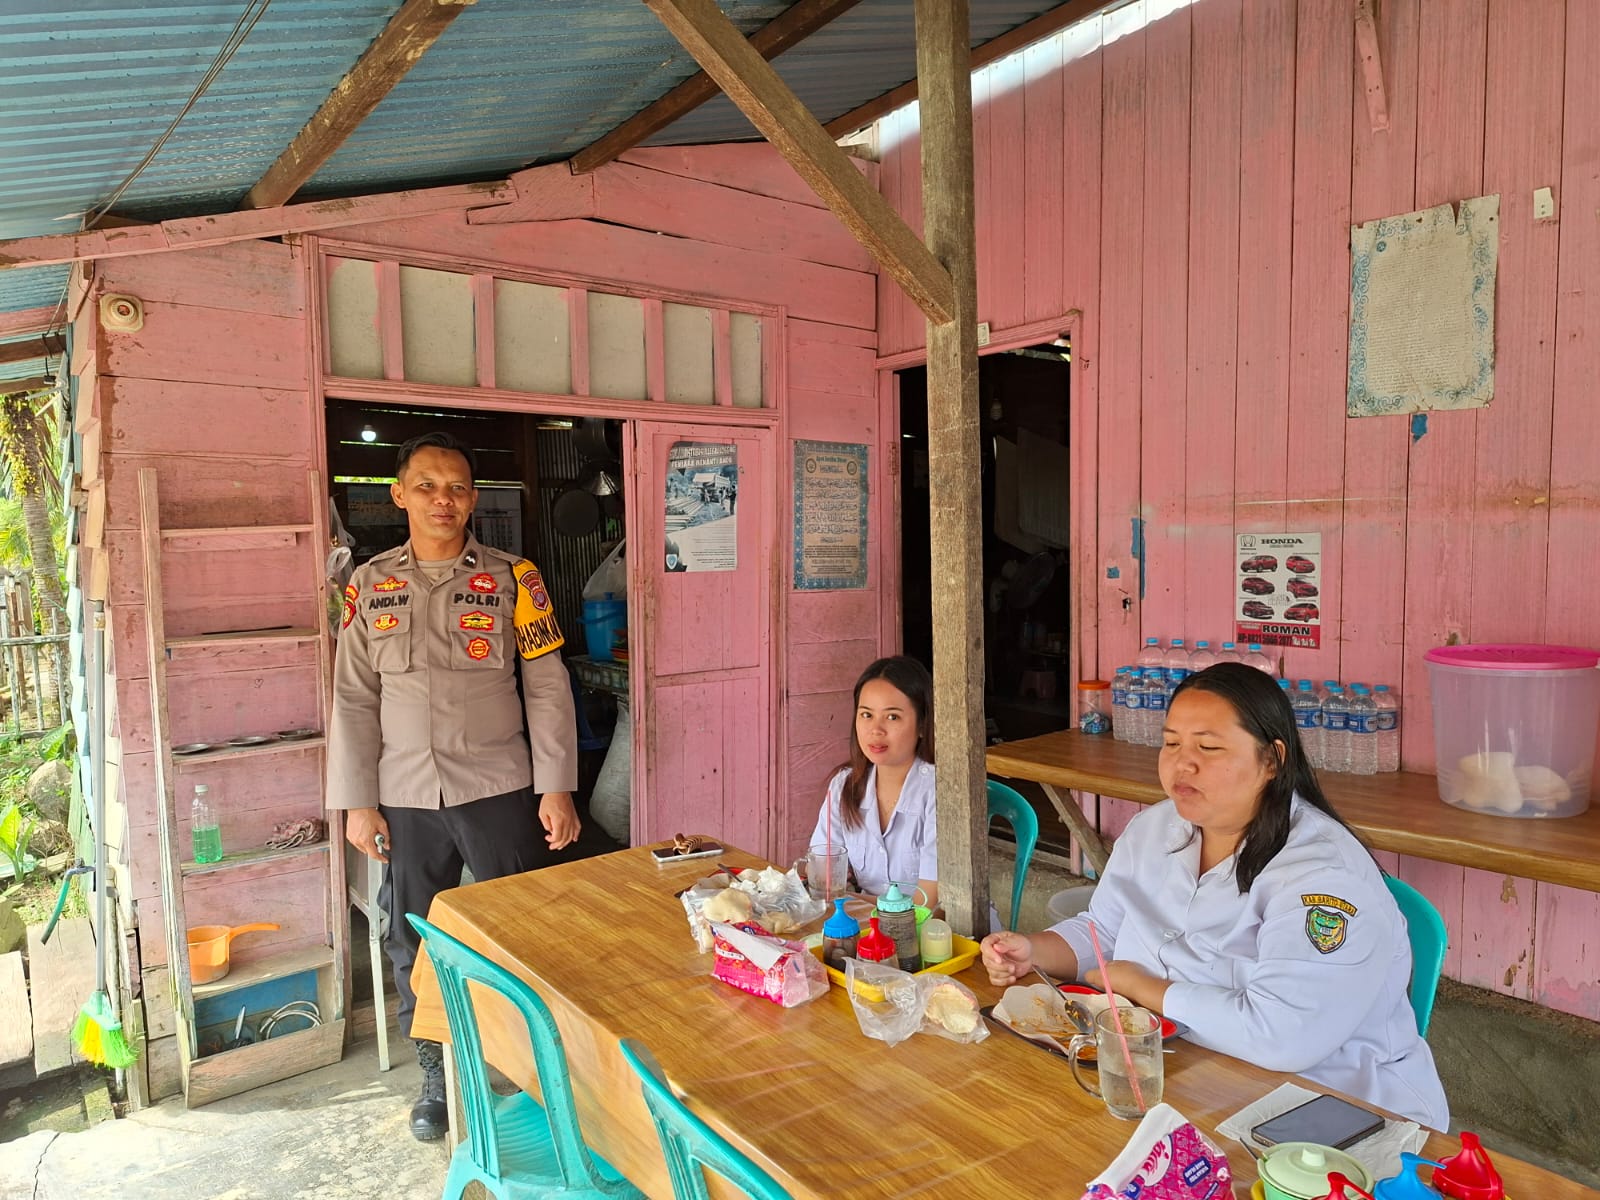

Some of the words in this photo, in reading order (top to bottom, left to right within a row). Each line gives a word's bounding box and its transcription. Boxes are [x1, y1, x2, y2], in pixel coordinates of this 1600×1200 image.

[369, 594, 409, 610] ANDI.W
[454, 593, 500, 607] POLRI
[1262, 624, 1311, 635] ROMAN
